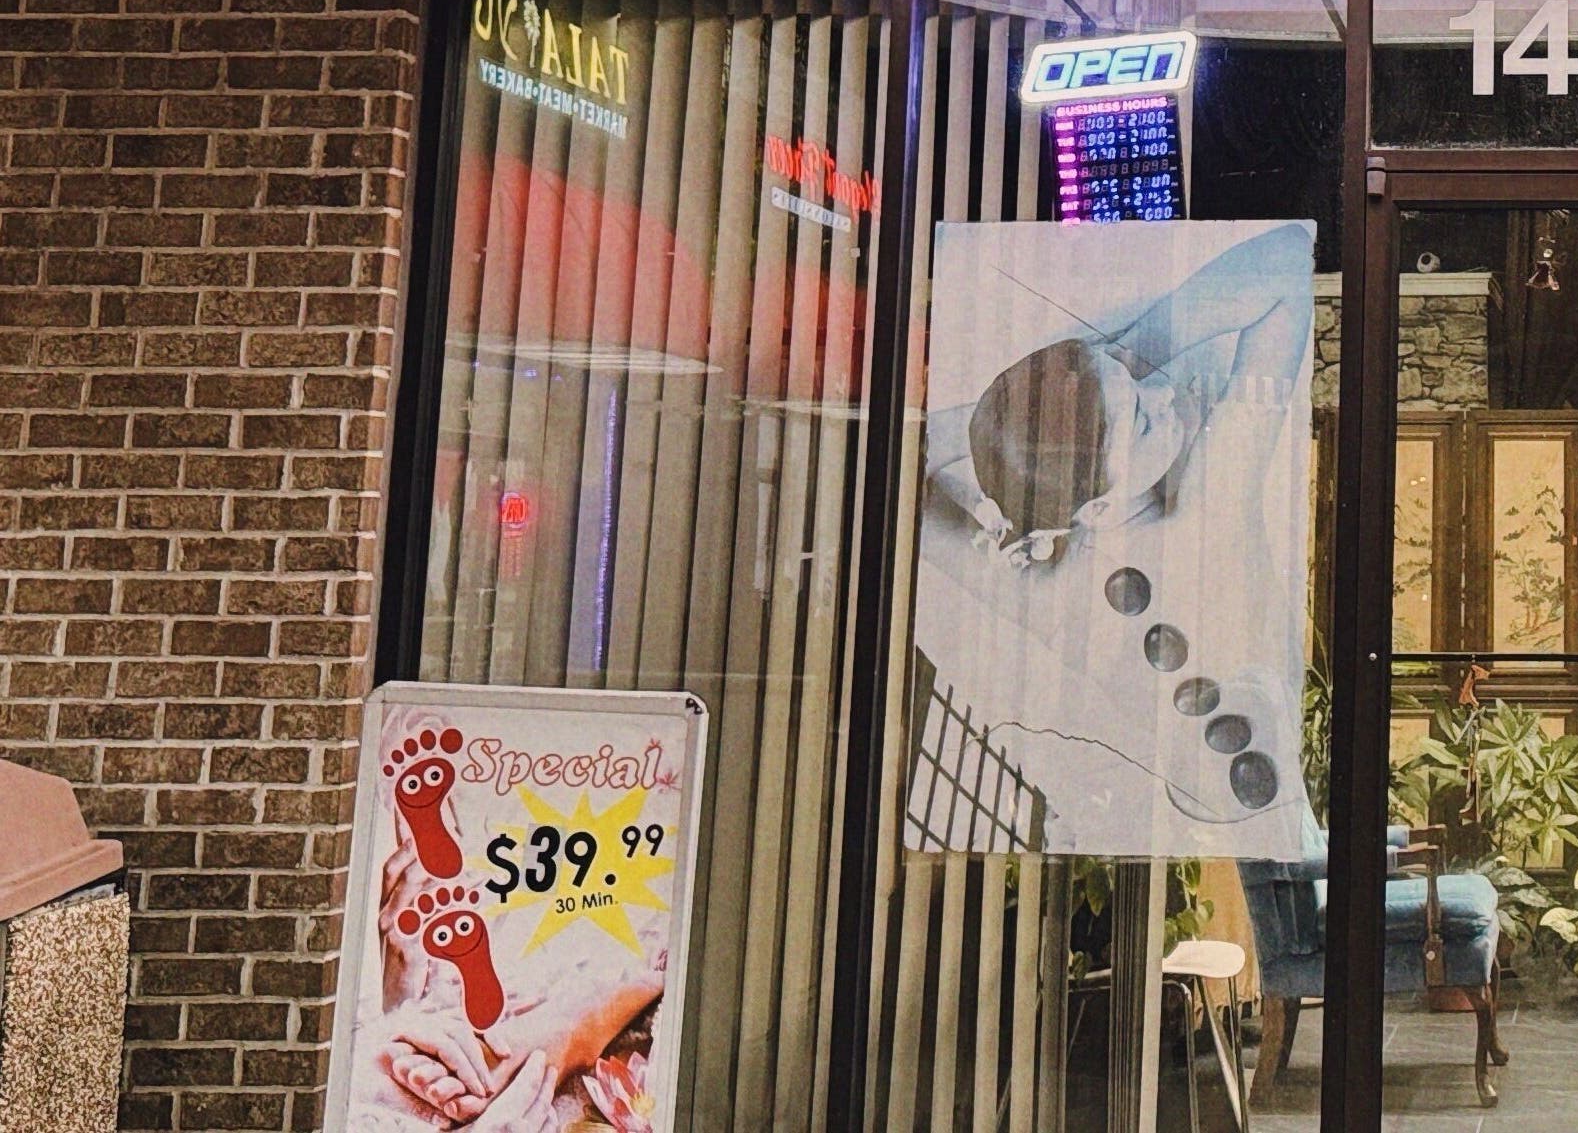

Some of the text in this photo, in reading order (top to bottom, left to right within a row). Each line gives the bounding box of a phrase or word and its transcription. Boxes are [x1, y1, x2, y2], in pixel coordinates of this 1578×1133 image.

[1032, 41, 1187, 93] OPEN
[461, 738, 664, 796] Special
[555, 897, 577, 915] 30
